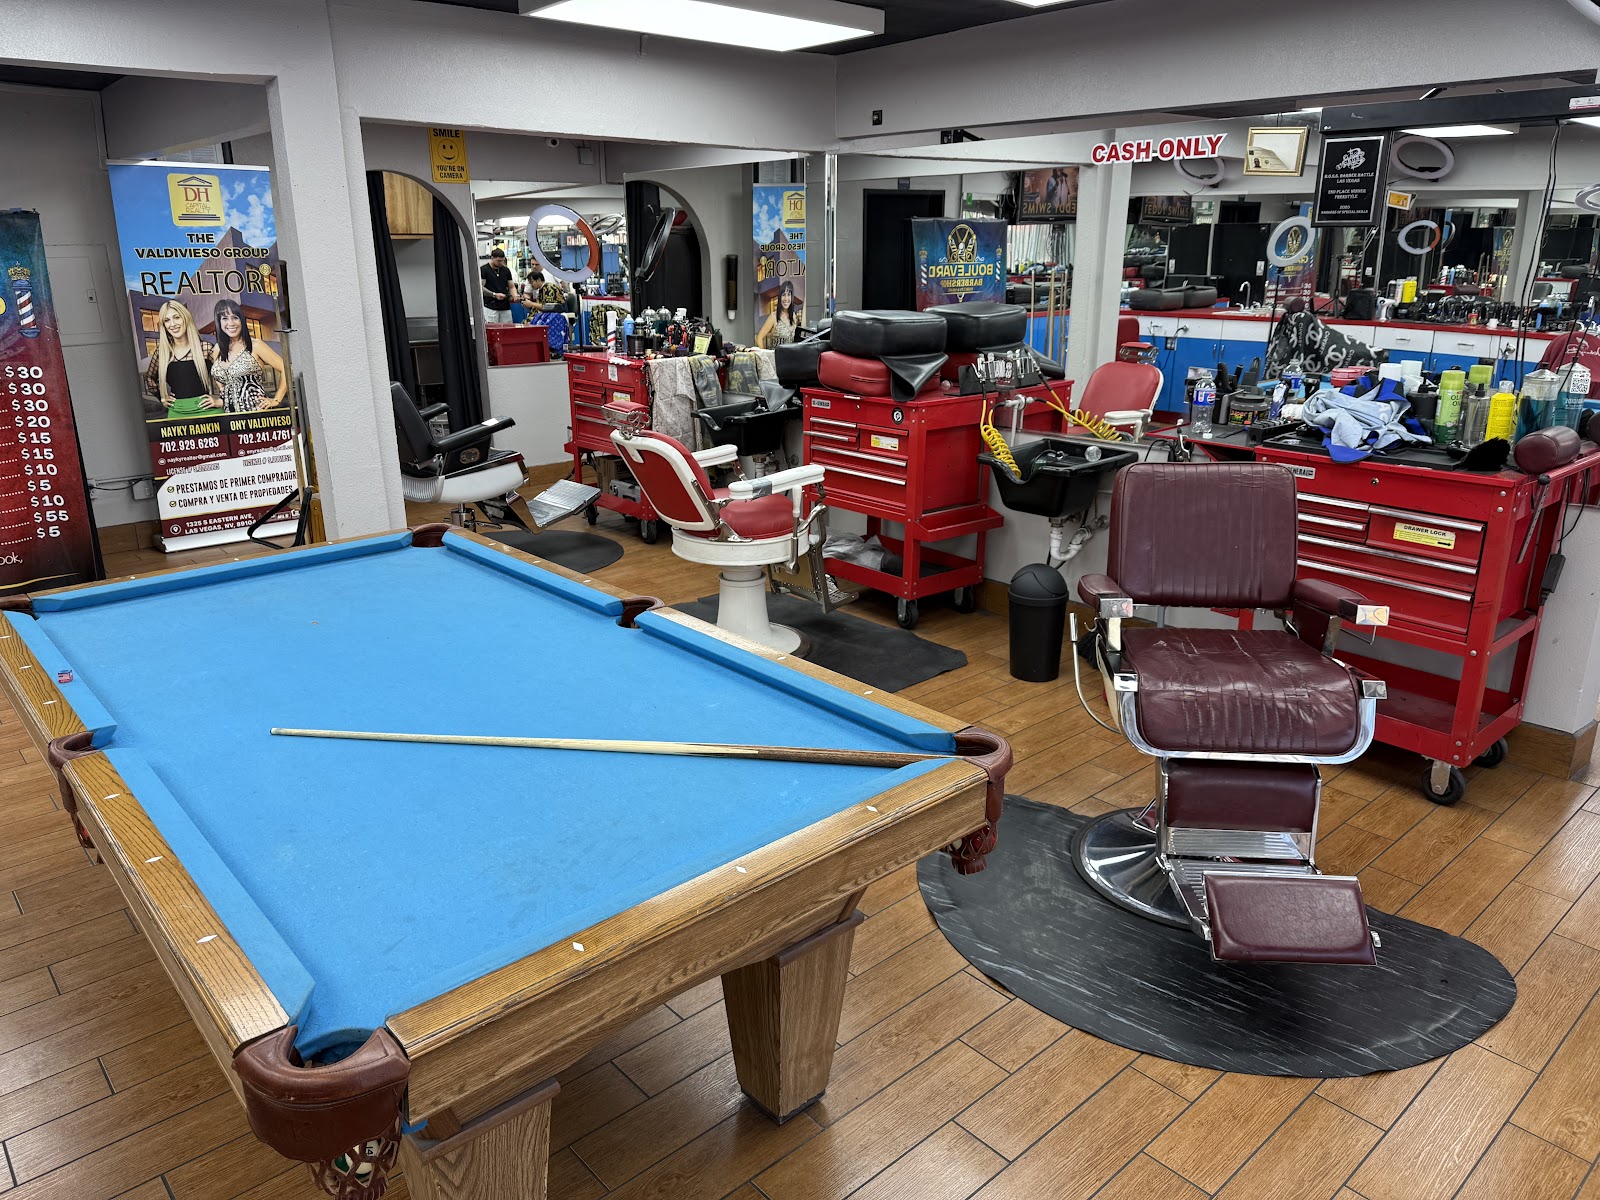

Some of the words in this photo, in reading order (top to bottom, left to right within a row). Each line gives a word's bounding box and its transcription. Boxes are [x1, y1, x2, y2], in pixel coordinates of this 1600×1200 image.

[432, 128, 460, 138] SMILE
[1092, 141, 1151, 163] CASH
[1159, 135, 1225, 159] ONLY
[184, 187, 210, 202] DH
[186, 233, 215, 244] THE
[134, 248, 221, 259] VALDIVIESO
[223, 248, 270, 259] GROUP
[140, 270, 265, 297] REALTOR
[160, 425, 188, 438] NAYKY
[189, 422, 220, 434] RANKIN
[230, 420, 246, 432] ONY
[248, 416, 292, 429] VALDIVIESO
[238, 430, 290, 444] 702.241.4761
[160, 437, 219, 453] 702.929.6263
[176, 480, 218, 494] PRESTAMOS
[220, 478, 228, 488] DE
[230, 476, 256, 488] PRIMER
[178, 495, 208, 508] COMPRA
[209, 494, 214, 504] Y
[216, 492, 238, 503] VENTA
[240, 491, 248, 500] DE
[250, 485, 293, 498] PROPIEDADES
[208, 515, 239, 525] EASTERN
[1404, 525, 1428, 534] DRAWER
